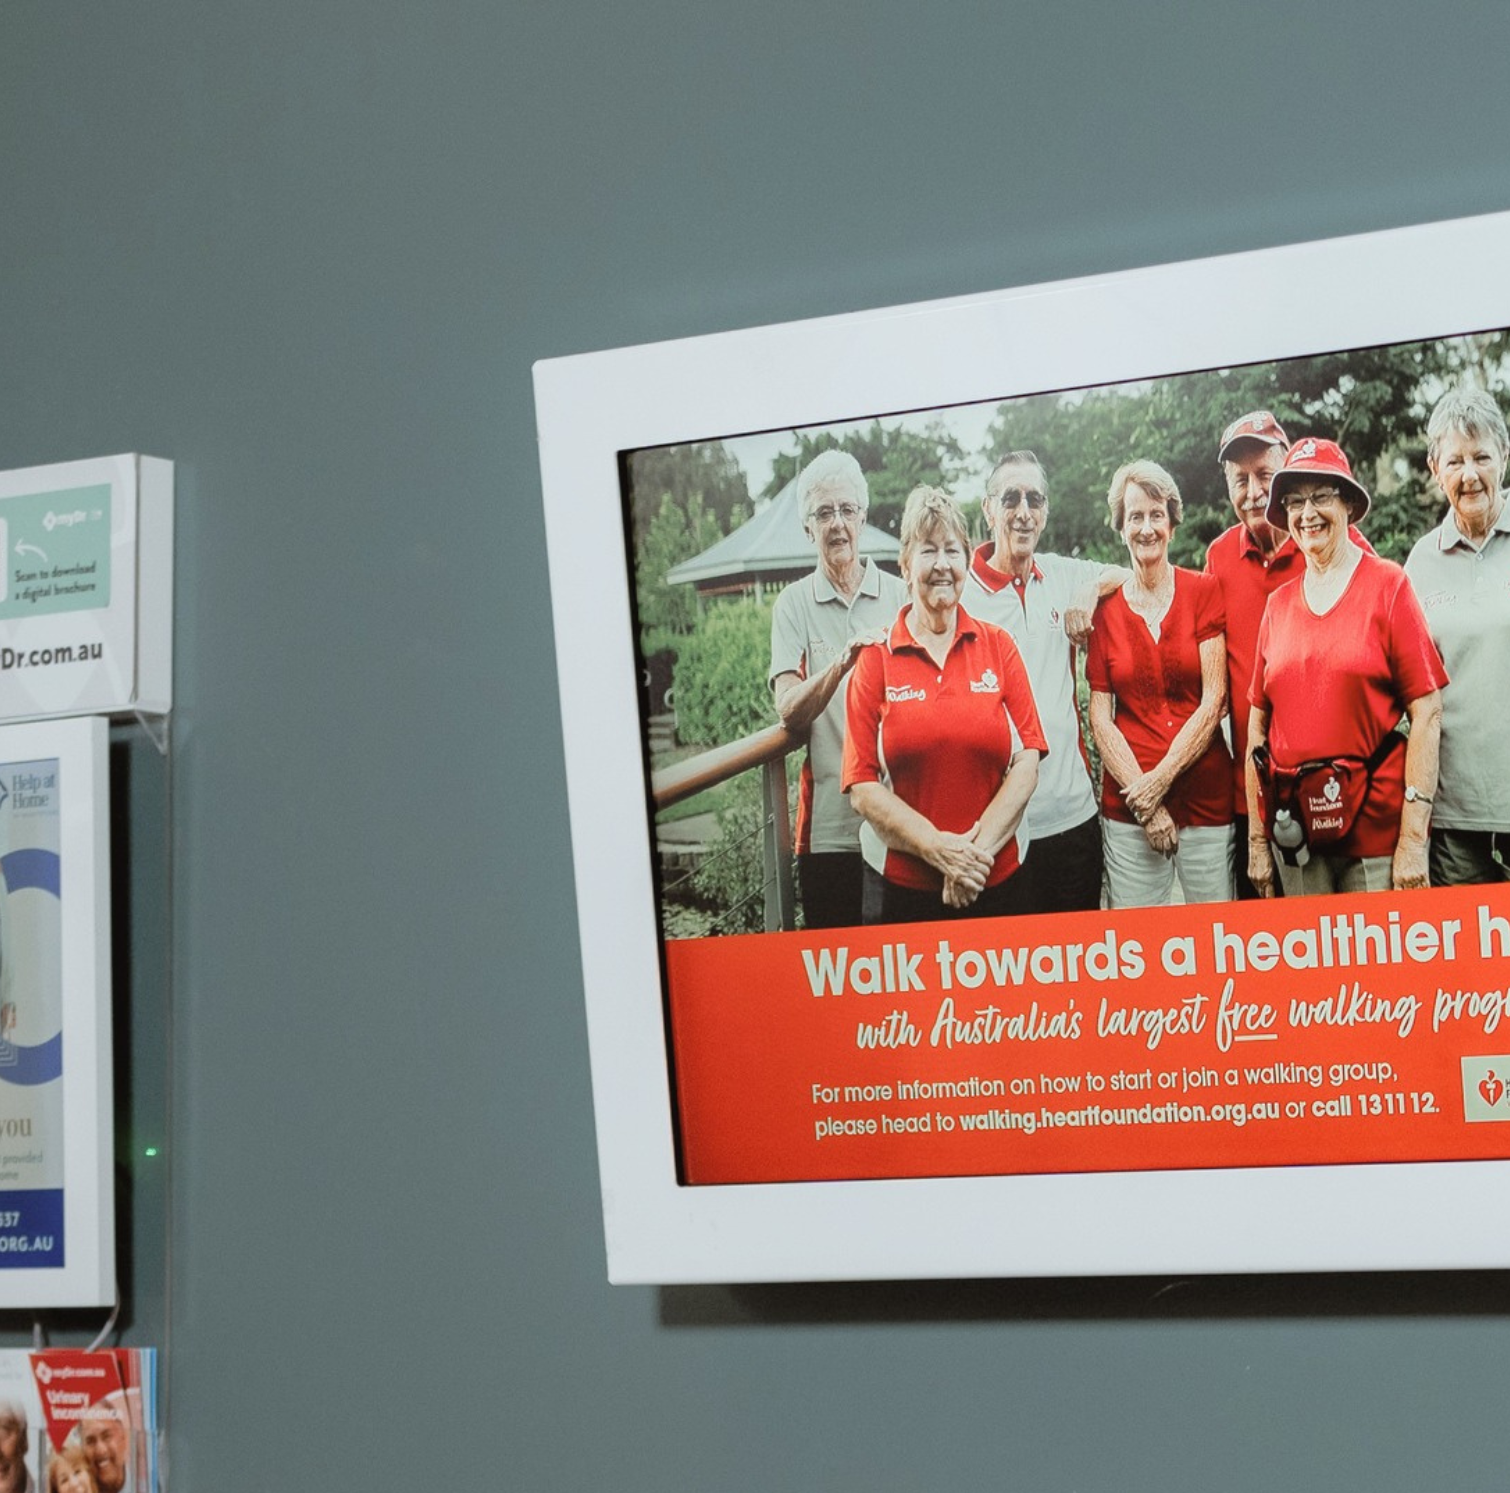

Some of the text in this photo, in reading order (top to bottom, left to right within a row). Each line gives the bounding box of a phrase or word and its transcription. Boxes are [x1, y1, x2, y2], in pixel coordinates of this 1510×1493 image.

[40, 569, 50, 580] to
[52, 562, 96, 578] download
[54, 581, 96, 597] brochure
[12, 773, 56, 792] Help at
[12, 792, 49, 810] Home
[801, 943, 925, 997] Walk
[936, 929, 1145, 989] towards
[1161, 936, 1196, 975] a
[1212, 910, 1461, 974] healthier
[857, 1009, 921, 1050] with
[930, 997, 1082, 1048] Australia's
[1096, 992, 1207, 1050] largest
[1215, 977, 1278, 1052] free
[1288, 982, 1420, 1037] walking
[812, 1060, 1397, 1104] For more information on how to start or join a walking group,
[814, 1115, 877, 1141] please
[882, 1111, 930, 1135] head
[935, 1113, 956, 1132] to
[960, 1100, 1280, 1136] walking.heartfoundation.org.au
[1285, 1102, 1307, 1119] or
[1312, 1094, 1351, 1118] call
[3, 1151, 43, 1168] provided
[46, 1390, 90, 1407] Urinary
